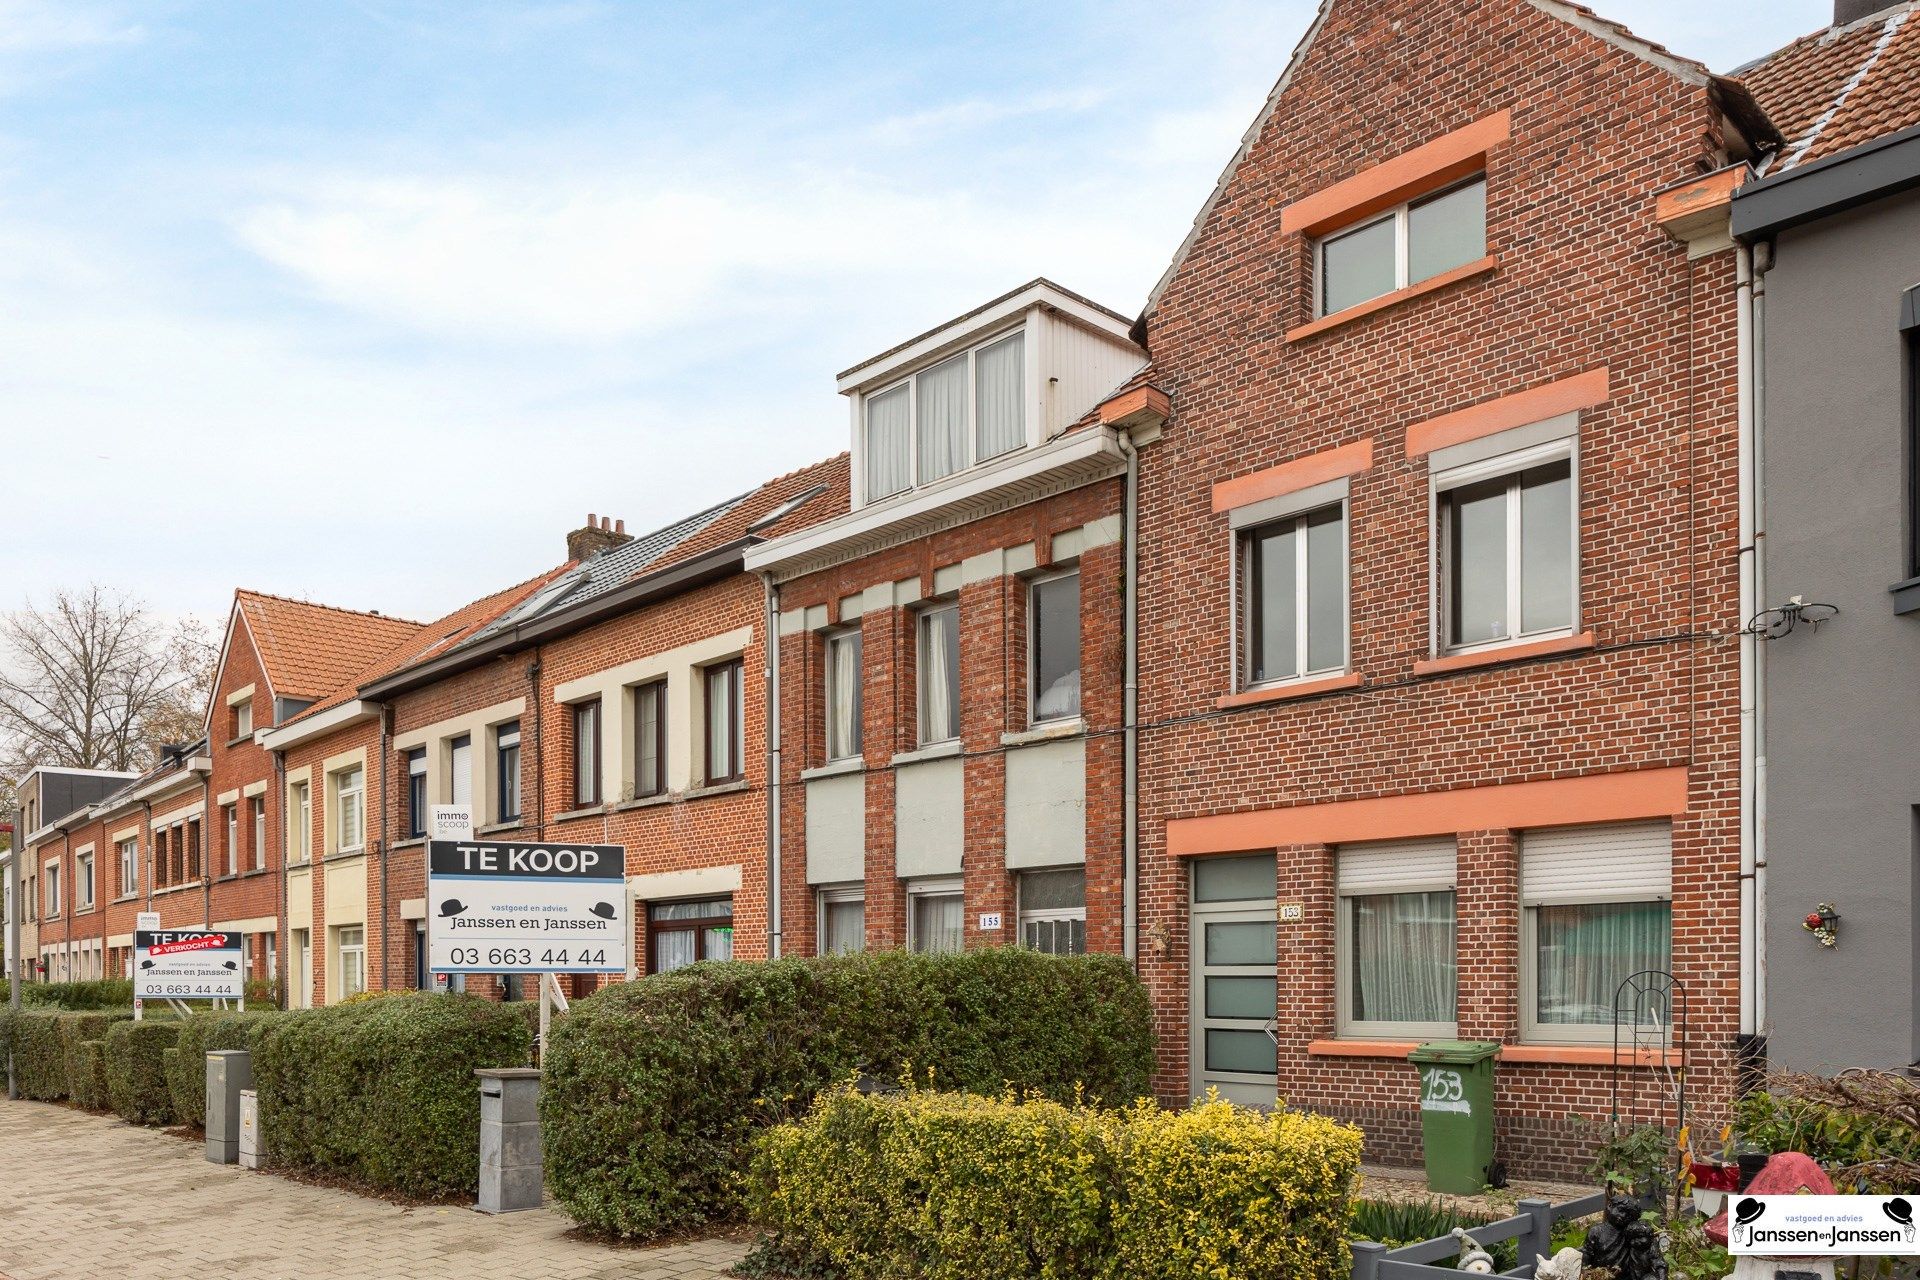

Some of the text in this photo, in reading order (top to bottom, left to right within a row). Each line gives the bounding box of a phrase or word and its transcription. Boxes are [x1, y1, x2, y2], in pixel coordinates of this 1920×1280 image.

[437, 811, 468, 820] immo
[438, 821, 468, 829] scoop
[456, 847, 599, 873] TE KOOP
[491, 904, 528, 914] vastgoed
[1284, 907, 1298, 918] 153
[450, 918, 607, 931] Janssen en Janssen
[983, 917, 998, 926] 155
[150, 934, 172, 945] TE
[164, 942, 209, 952] VERKOCHT
[450, 948, 606, 965] 03 663 44 44
[146, 985, 232, 994] 03 663 44 44
[1422, 1068, 1463, 1101] 153
